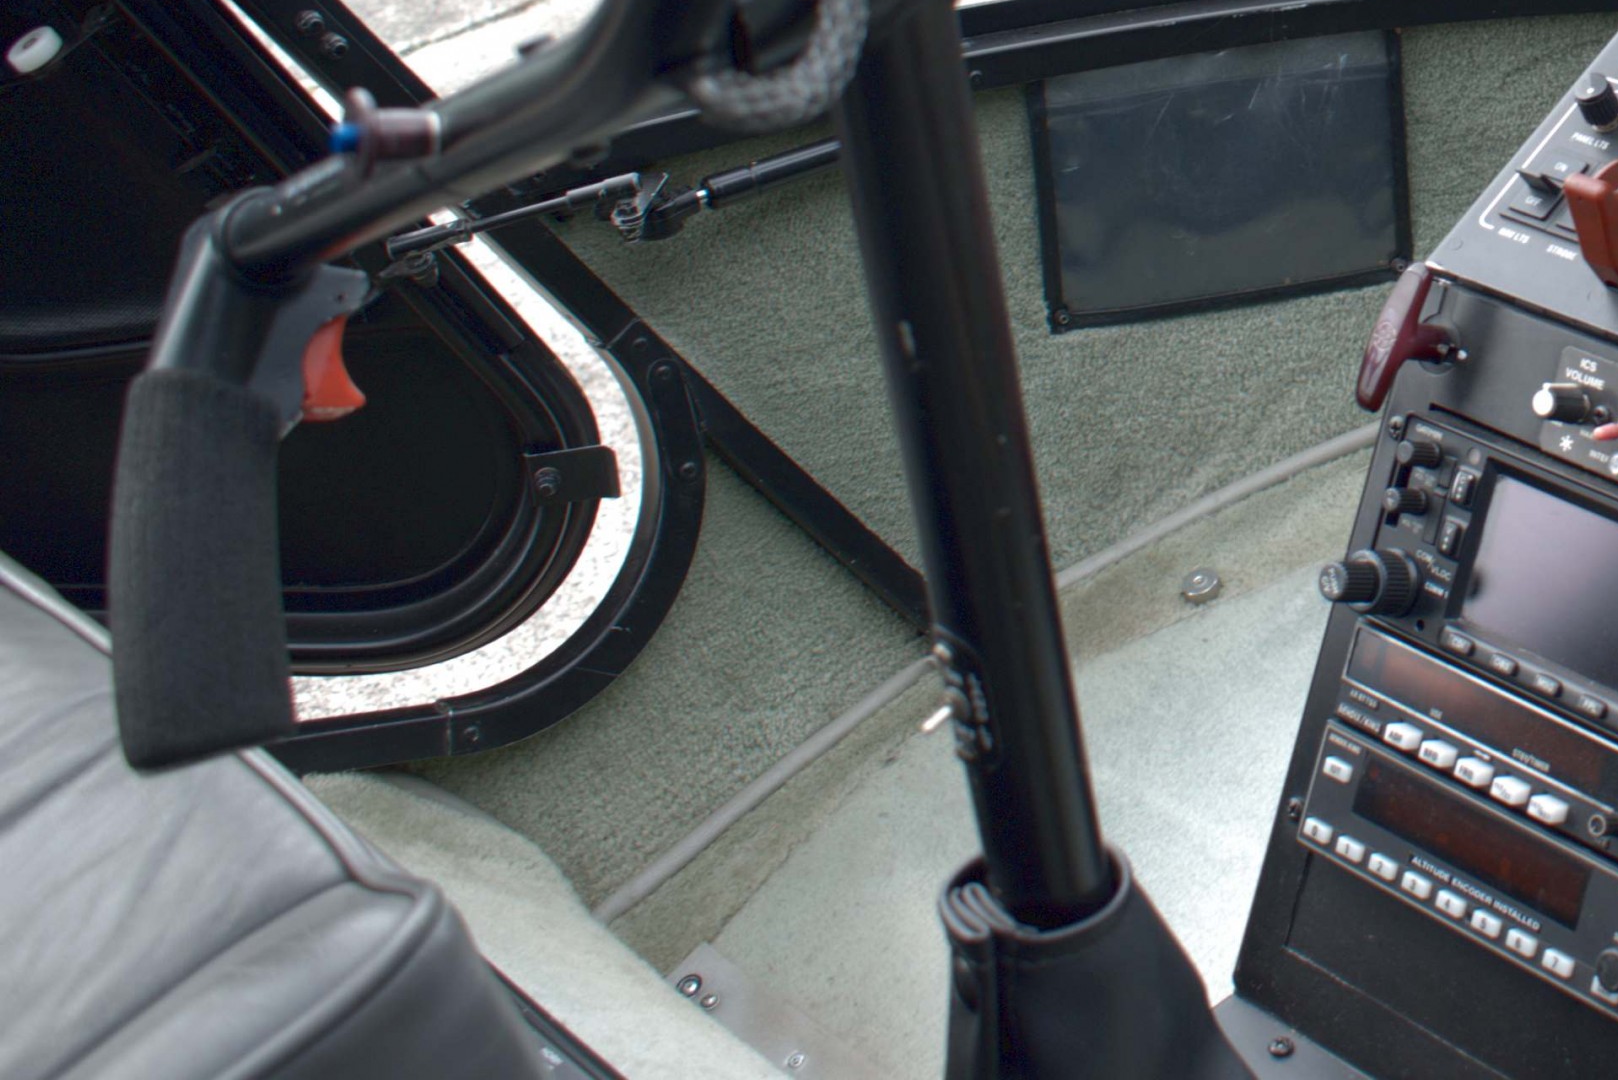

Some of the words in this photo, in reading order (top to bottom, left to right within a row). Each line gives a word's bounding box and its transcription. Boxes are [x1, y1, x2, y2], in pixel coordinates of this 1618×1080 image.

[1571, 131, 1595, 147] PANEL
[1594, 139, 1611, 151] LTS
[1546, 243, 1579, 261] STROBE
[1579, 358, 1598, 373] ICS
[1565, 367, 1605, 391] VOLUME
[1411, 855, 1450, 883] ALTITUDE
[1450, 877, 1493, 906] ENCODER
[1493, 899, 1541, 931] INSTALLED
